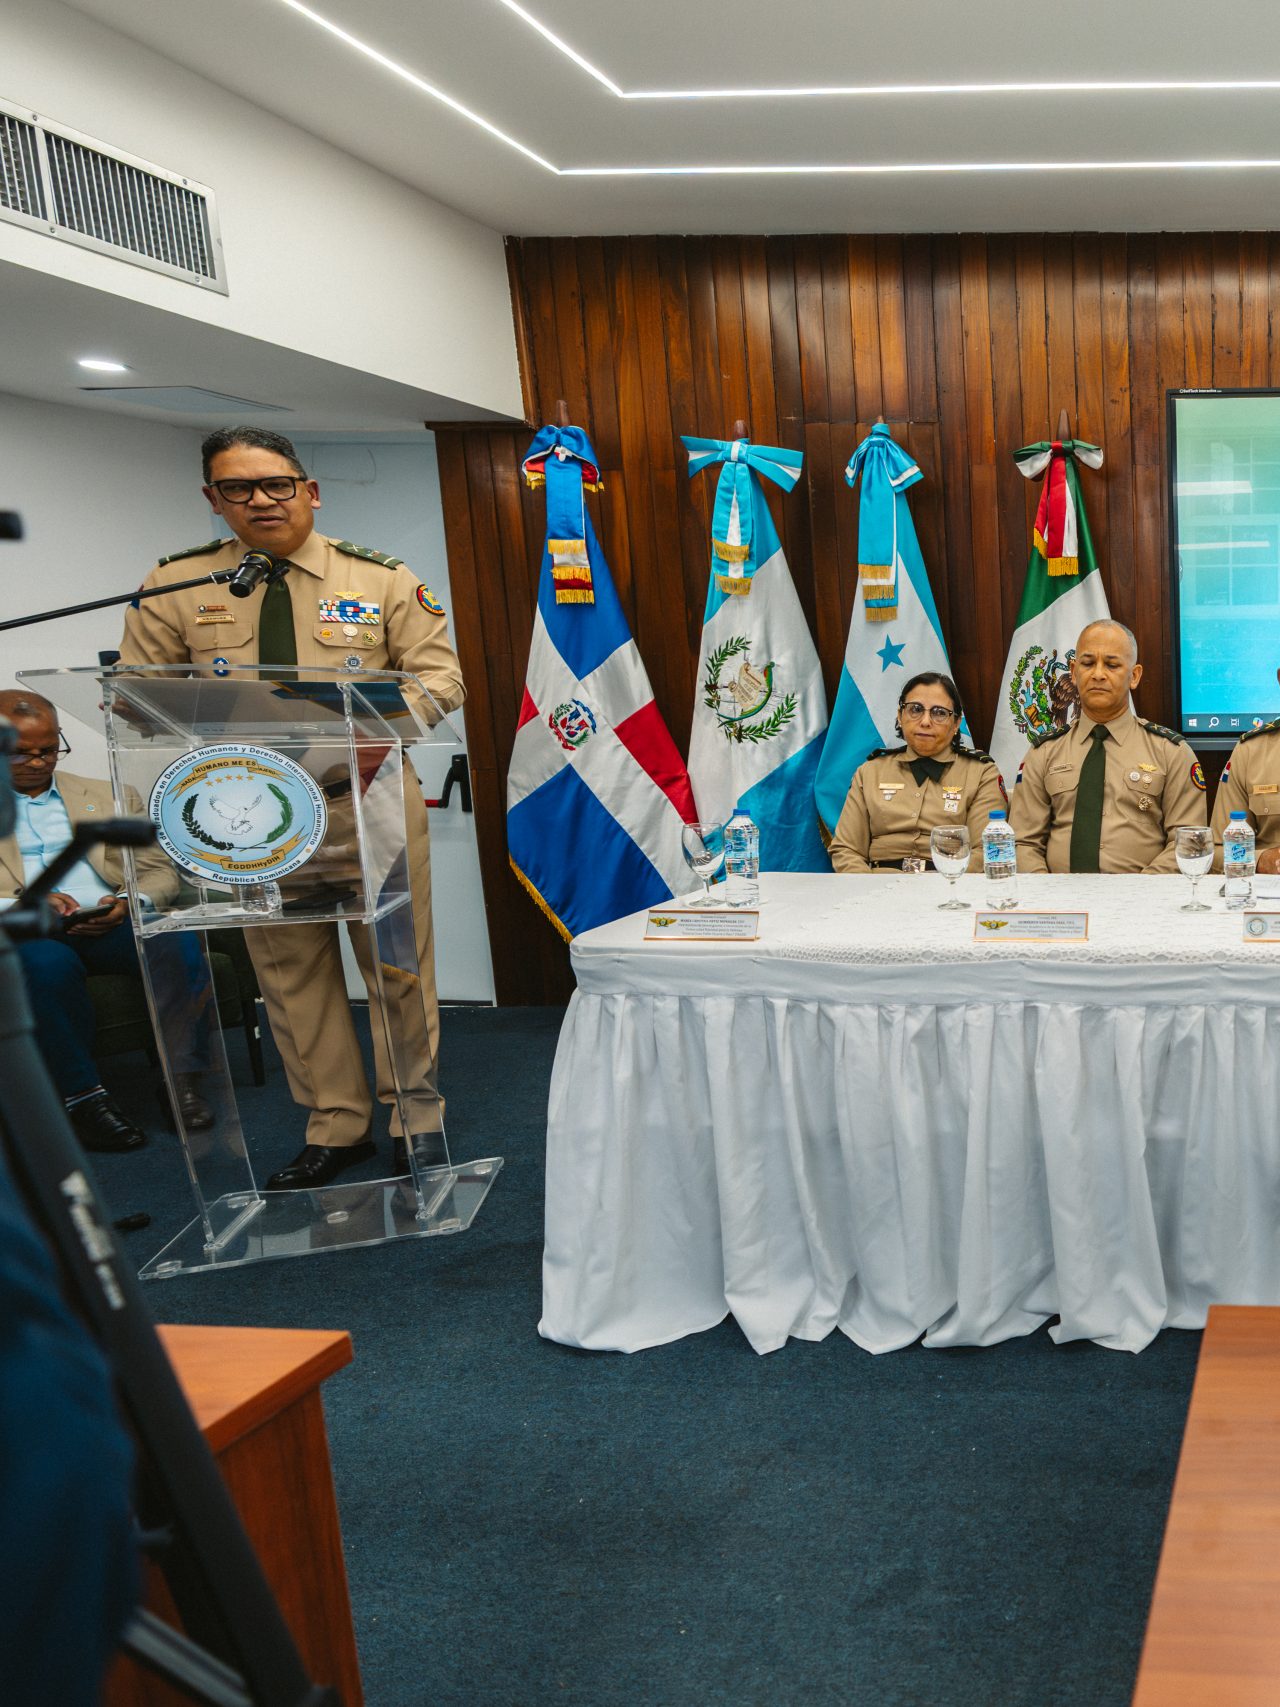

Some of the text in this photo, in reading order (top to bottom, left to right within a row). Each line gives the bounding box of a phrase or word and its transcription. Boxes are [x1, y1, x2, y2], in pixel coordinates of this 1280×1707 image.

[198, 746, 238, 756] Humanos
[250, 746, 284, 764] Derecho
[164, 755, 197, 780] Derechos
[195, 760, 229, 774] HUMANO
[258, 767, 276, 775] AJENO
[160, 778, 167, 789] en
[181, 776, 196, 787] NADA
[284, 760, 319, 802] Internacional
[310, 804, 322, 846] Humanitario
[158, 831, 167, 841] de
[165, 841, 191, 866] Escuela
[228, 856, 280, 870] EGDDHHyDIH
[212, 860, 301, 883] República Dominicana
